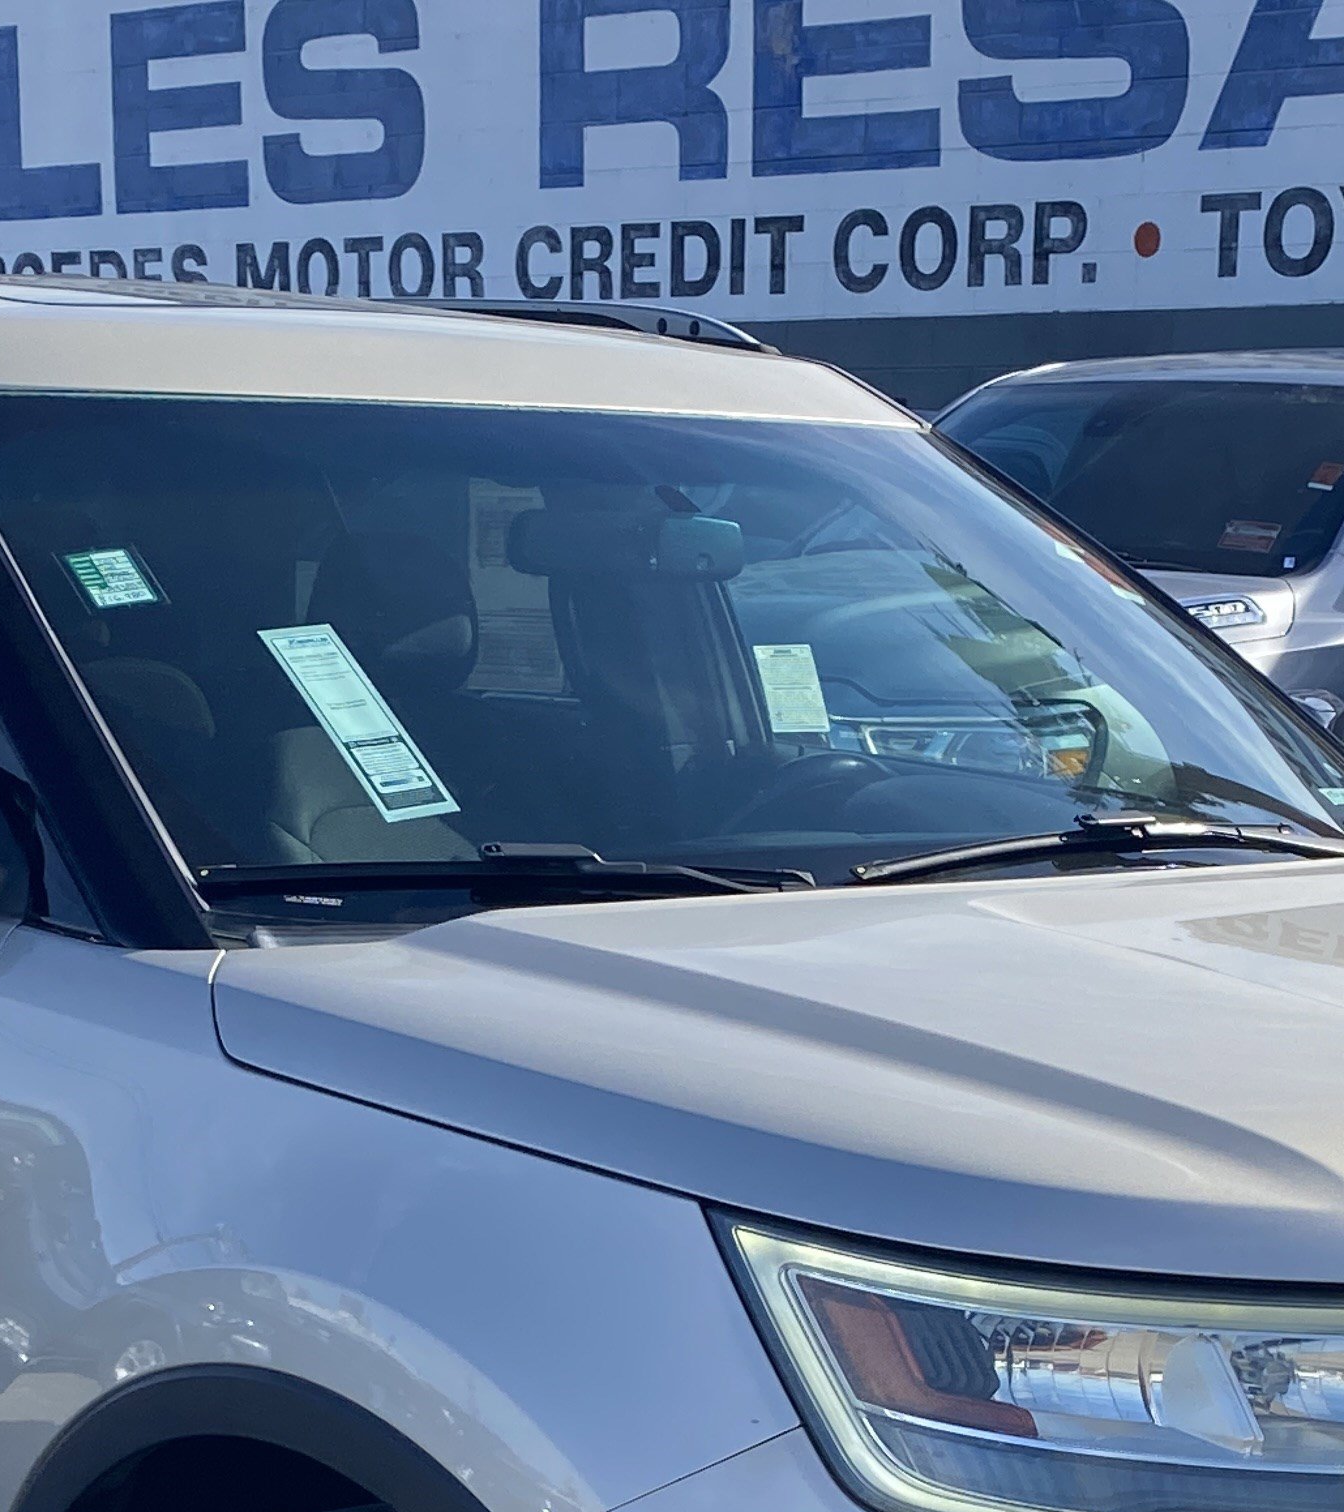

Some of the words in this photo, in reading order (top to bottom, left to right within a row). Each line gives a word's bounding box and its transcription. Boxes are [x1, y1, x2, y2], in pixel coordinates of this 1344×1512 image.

[235, 231, 485, 299] MOTOR
[515, 214, 805, 301] CREDIT
[833, 200, 1098, 294] CORP.
